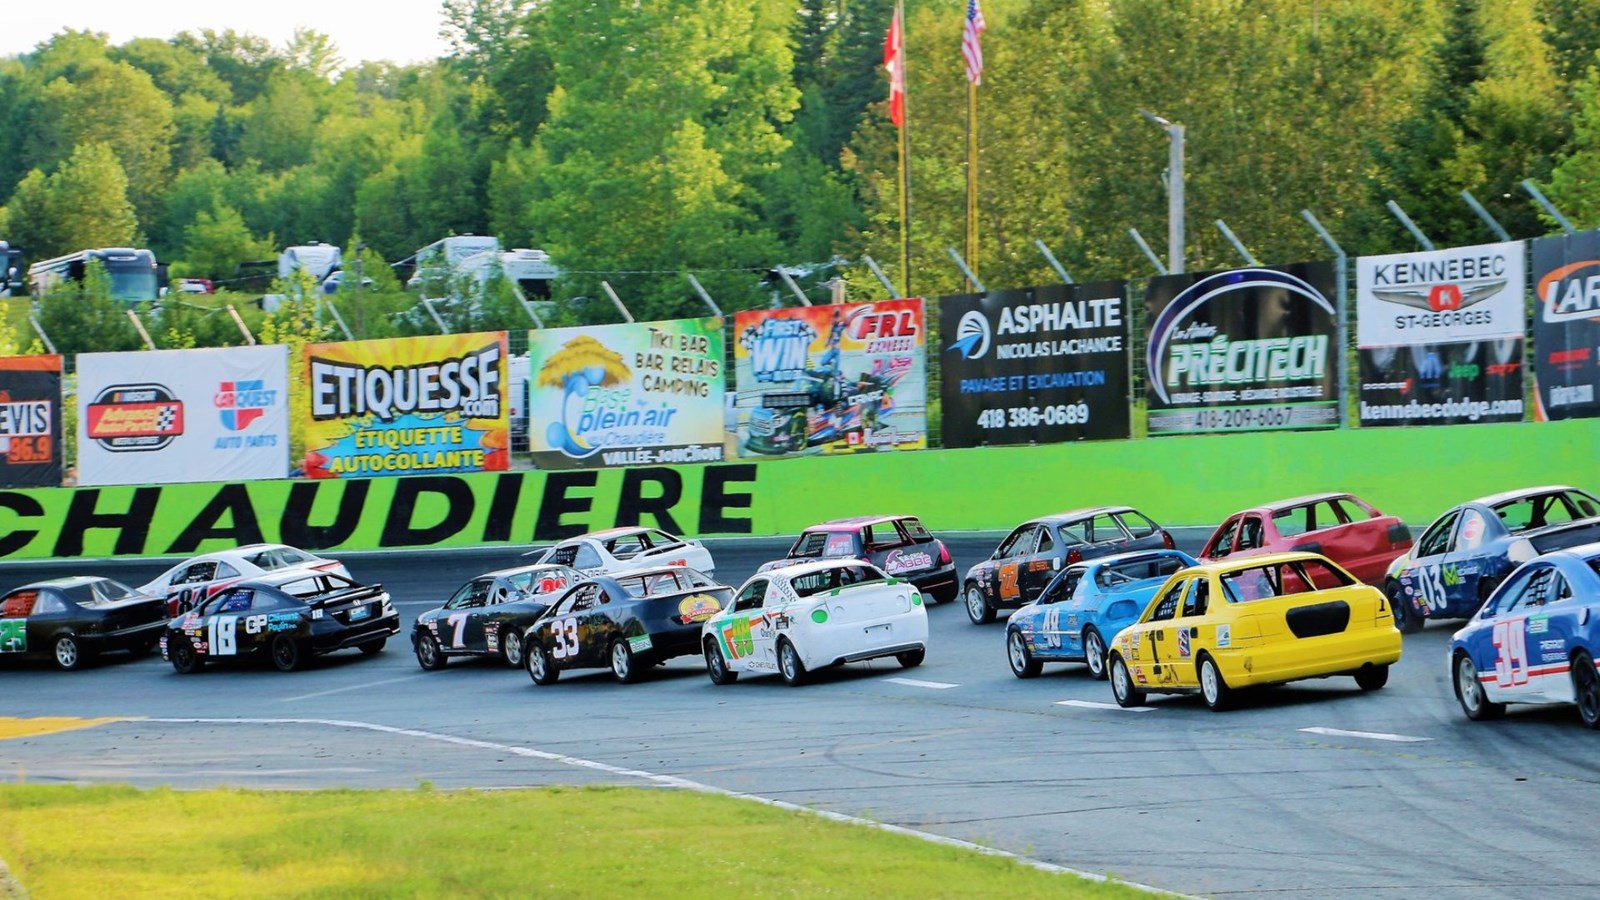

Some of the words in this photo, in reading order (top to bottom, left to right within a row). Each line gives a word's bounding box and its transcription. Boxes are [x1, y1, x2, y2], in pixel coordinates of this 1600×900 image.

[1374, 254, 1506, 285] KENNEBEC
[1439, 289, 1453, 305] K
[857, 312, 916, 340] FRL
[997, 297, 1122, 335] ASPHALTE
[1395, 310, 1492, 329] ST-GEORGES
[680, 335, 708, 354] BAR
[752, 337, 809, 371] WIN
[996, 341, 1051, 360] NICOLAS
[1052, 336, 1122, 356] LACHANCE
[635, 352, 664, 371] BAR
[671, 356, 719, 376] RELAIS
[1167, 334, 1329, 387] PRÉCITECH
[311, 345, 500, 421] ETIQUESSE
[643, 375, 708, 398] CAMPING
[960, 377, 1007, 394] PAVAGE
[1009, 375, 1026, 391] ET
[1028, 370, 1106, 390] EXCAVATION
[577, 406, 639, 436] plein
[643, 402, 677, 428] air
[977, 408, 1006, 429] 418
[1008, 403, 1090, 427] 386-0689
[1195, 406, 1294, 429] 418-209-6067
[1360, 396, 1524, 421] kennebecdodge.com
[9, 436, 53, 463] 96.9
[213, 436, 243, 450] AUTO
[245, 433, 279, 448] PARTS
[355, 425, 462, 449] ÉTIQUETTE
[329, 450, 484, 473] AUTOCOLLANTE
[0, 464, 757, 557] CHAUDIERE
[1418, 563, 1447, 611] 03
[312, 608, 323, 619] 18
[1378, 598, 1386, 613] 1
[207, 615, 239, 656] 18
[447, 611, 471, 649] 7
[550, 617, 579, 659] 33
[1492, 616, 1529, 689] 39
